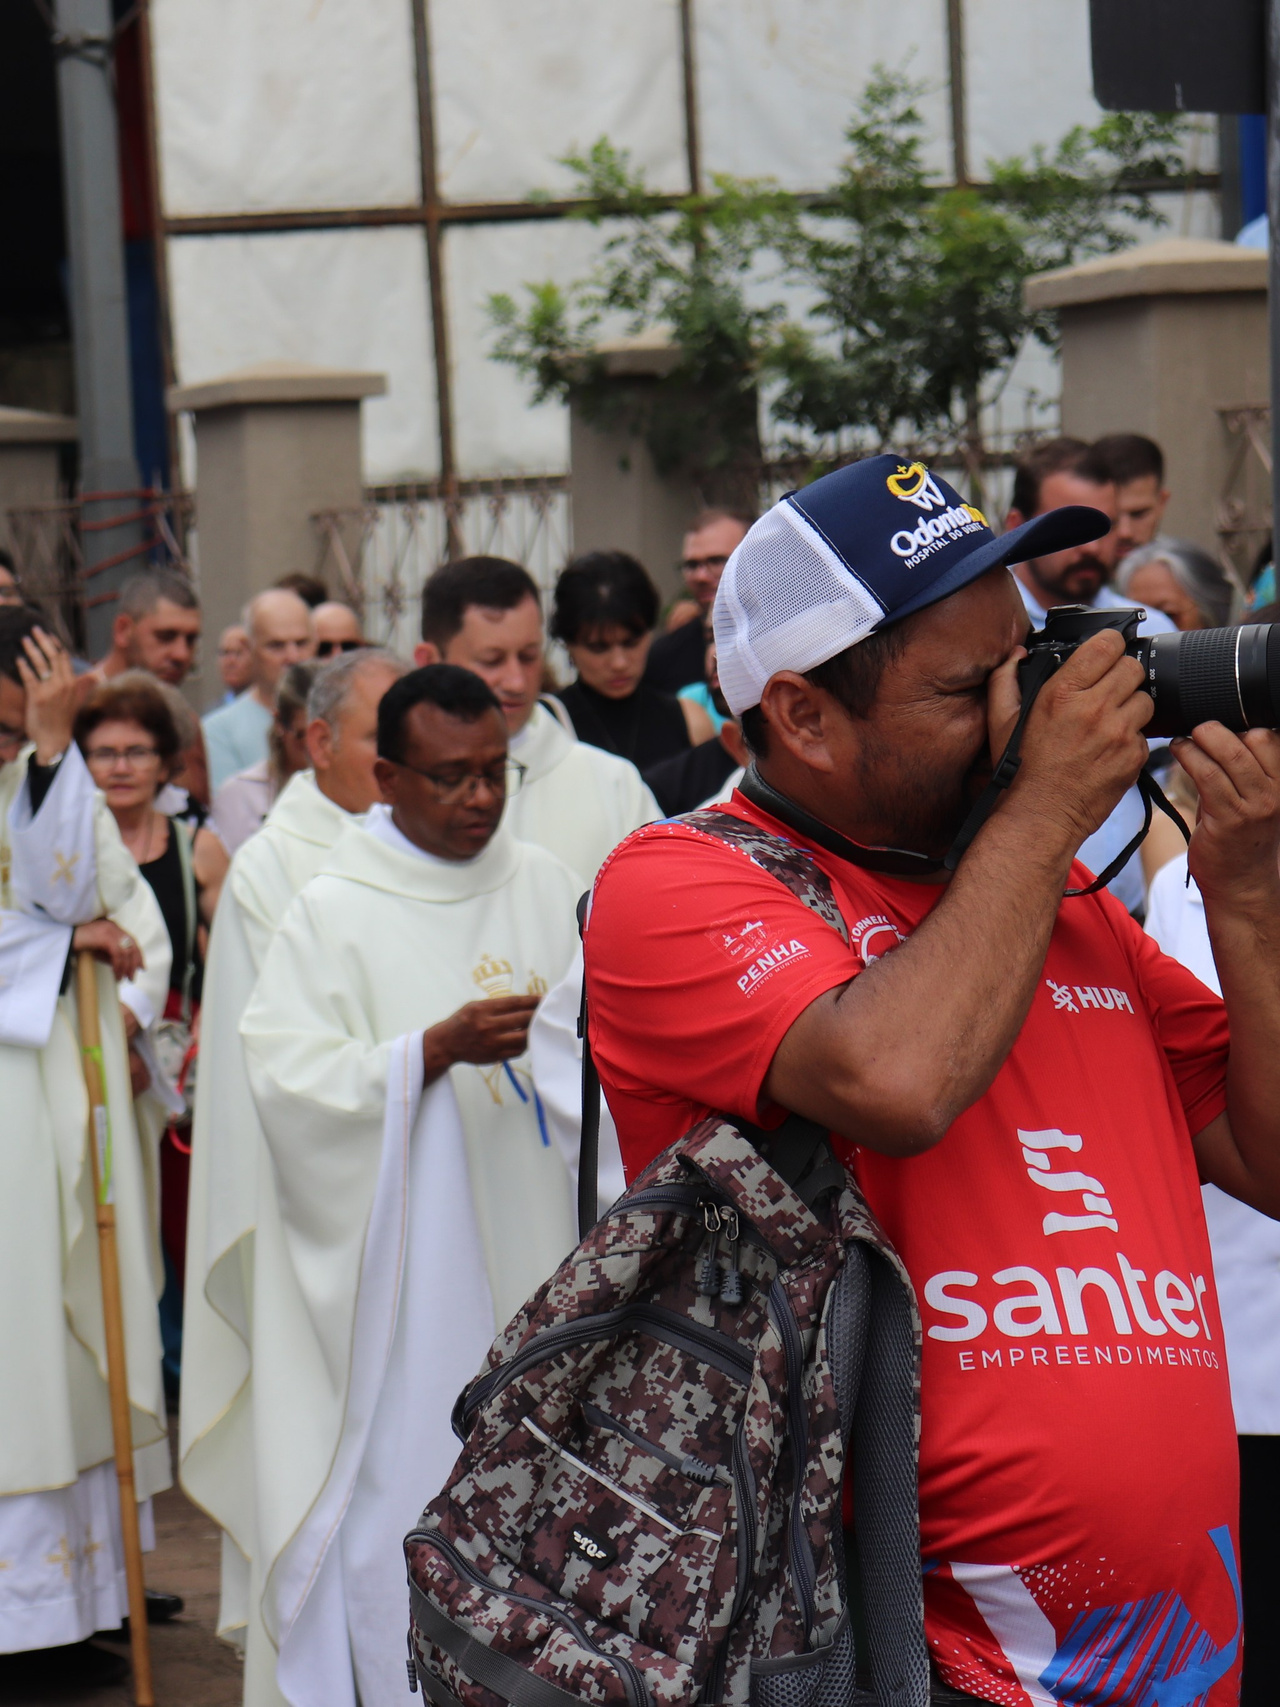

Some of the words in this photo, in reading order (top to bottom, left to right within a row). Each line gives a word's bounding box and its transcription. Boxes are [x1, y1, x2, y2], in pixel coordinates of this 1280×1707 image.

[904, 537, 950, 569] HOSPITAL
[948, 529, 963, 541] DO
[737, 939, 807, 992] PENHA
[746, 972, 774, 999] GOVERNO
[775, 953, 813, 973] MUNICIPAL
[1072, 986, 1135, 1014] HUPI
[923, 1252, 1213, 1343] santer
[958, 1345, 1220, 1372] EMPREENDIMENTOS
